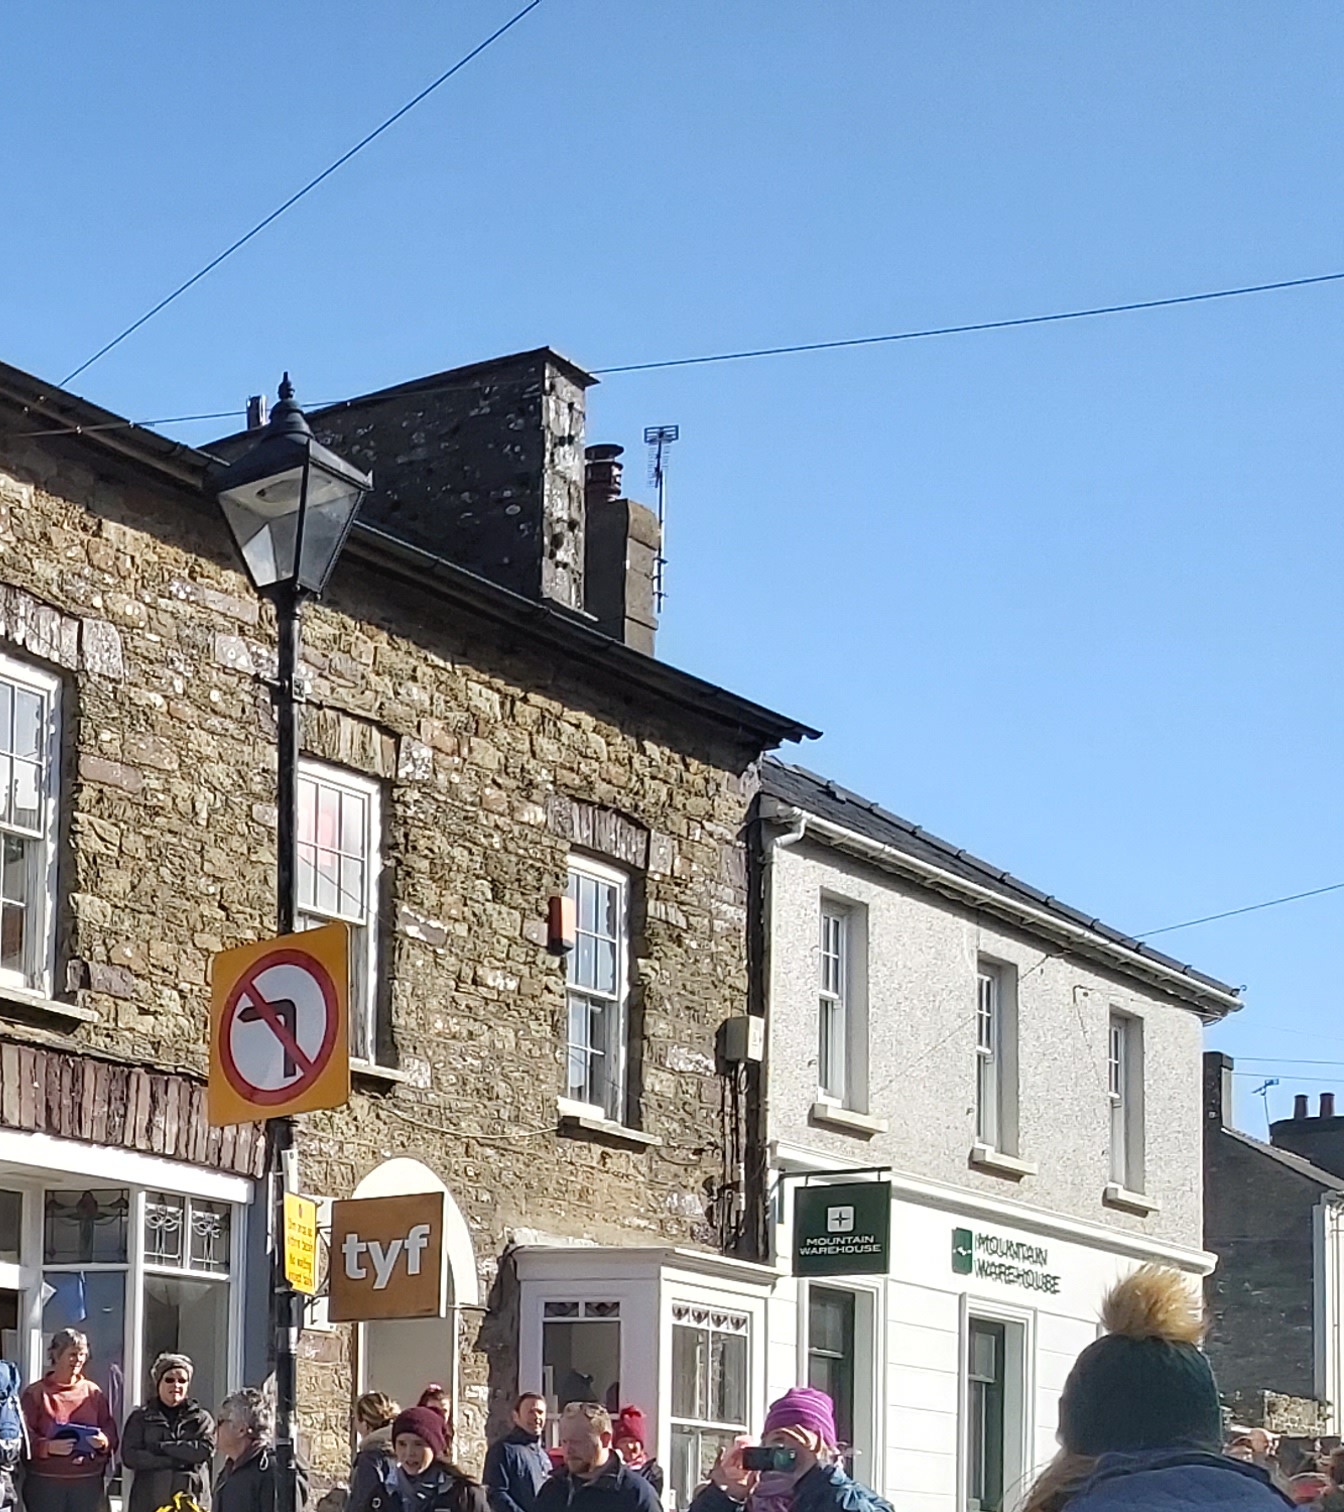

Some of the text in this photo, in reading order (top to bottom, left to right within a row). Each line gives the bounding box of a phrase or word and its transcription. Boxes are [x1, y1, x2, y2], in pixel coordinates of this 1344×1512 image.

[342, 1223, 431, 1290] tyf
[799, 1244, 882, 1256] WAREHOUSE
[806, 1235, 875, 1246] MOUNTAIN
[975, 1232, 1048, 1268] MOUNTAIN
[974, 1257, 1062, 1295] WAREHOUSE
